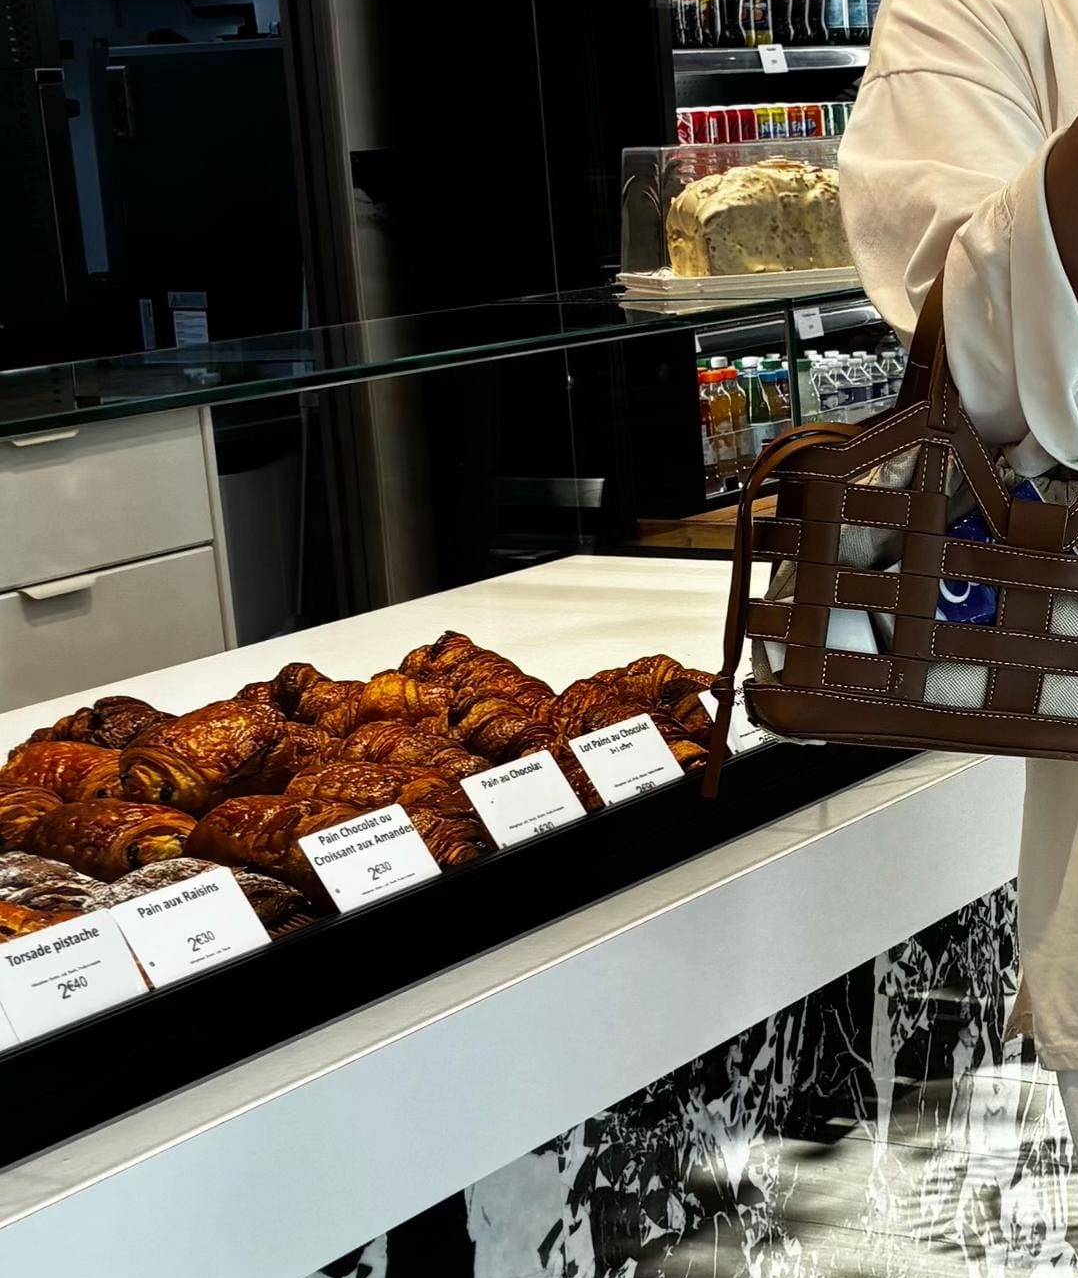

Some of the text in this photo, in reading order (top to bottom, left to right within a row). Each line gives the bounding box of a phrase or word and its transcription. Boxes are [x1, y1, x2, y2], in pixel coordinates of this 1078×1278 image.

[579, 722, 650, 753] Lot Pains au Chocolat
[481, 762, 543, 789] Pain au Chocolat
[314, 823, 415, 866] Croissant aux Amandes
[318, 813, 392, 846] Pain Chocolat ou
[367, 861, 392, 881] 2€30
[137, 882, 219, 918] Pain aux Raisins
[5, 927, 100, 967] Torsade pistache
[187, 930, 215, 952] 2€30
[57, 975, 88, 999] 2€40
